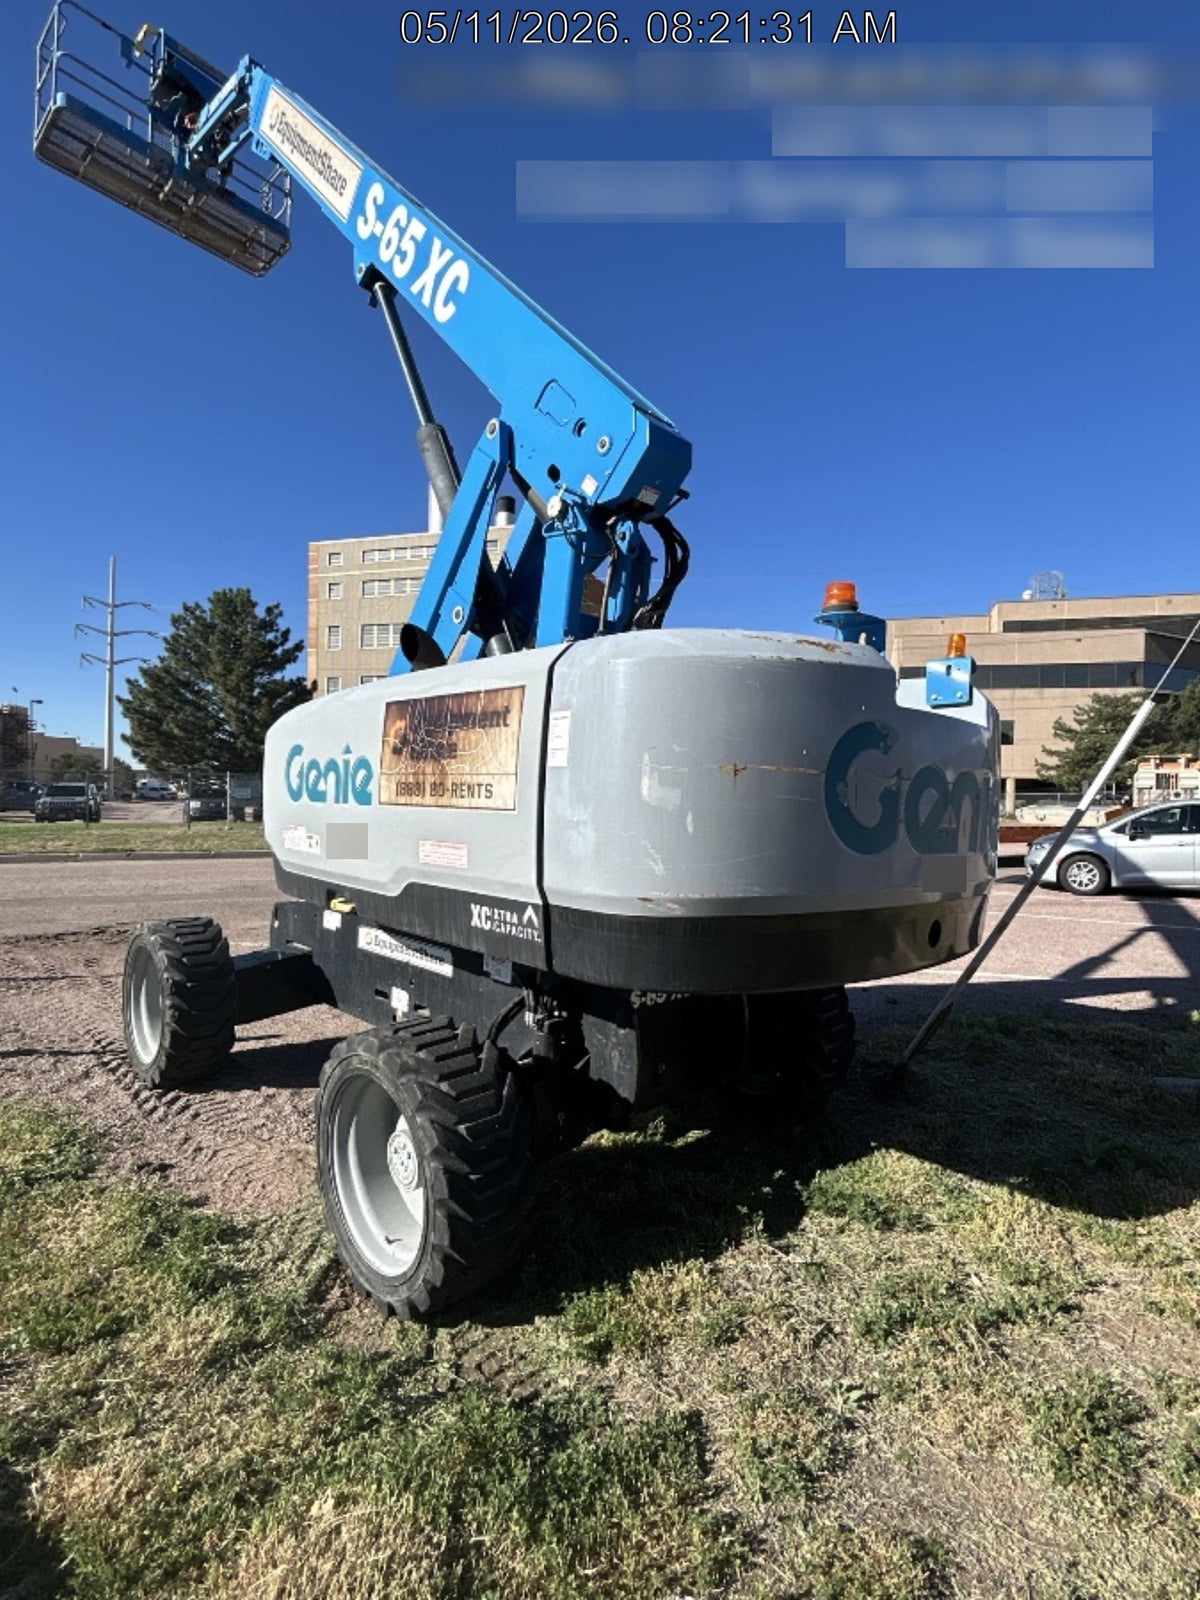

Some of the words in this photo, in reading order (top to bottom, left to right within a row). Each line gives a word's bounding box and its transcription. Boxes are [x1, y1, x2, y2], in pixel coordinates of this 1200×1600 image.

[277, 111, 348, 197] EquipmentShare
[356, 182, 428, 279] S-65
[409, 236, 470, 324] XC
[285, 741, 374, 806] Genie
[470, 903, 491, 931] XC
